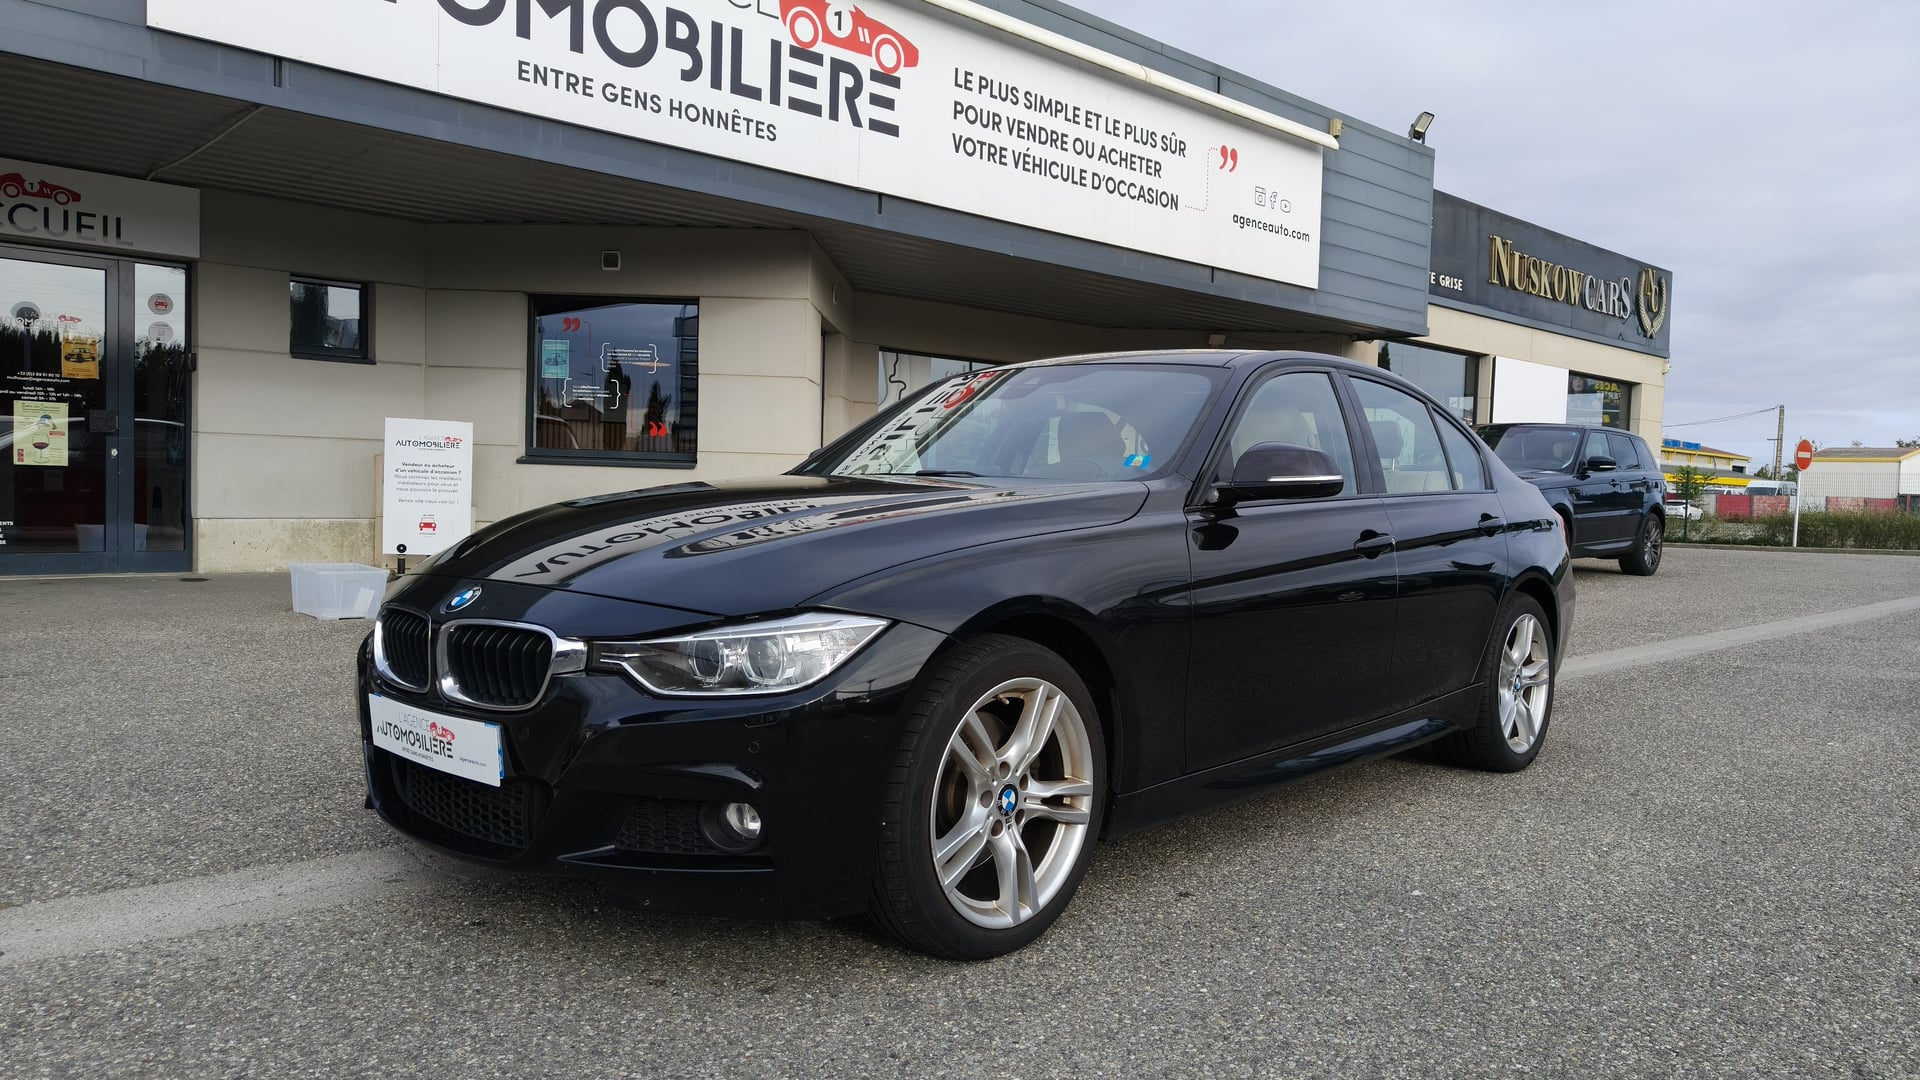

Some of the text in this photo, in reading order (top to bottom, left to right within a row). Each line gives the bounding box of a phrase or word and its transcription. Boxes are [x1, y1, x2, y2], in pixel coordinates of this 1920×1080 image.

[517, 60, 778, 142] ENTRE GENS HONNÊTES
[953, 100, 1162, 179] POUR VENDRE OU ACHETER
[954, 66, 1187, 159] LE PLUS SIMPLE ET LE PLUS SÛR
[952, 133, 1180, 212] VOTRE VÉHICULE D'OCCASION
[0, 202, 134, 247] CUEIL
[1232, 212, 1310, 243] agenceauto.com
[1439, 274, 1463, 291] GRISE
